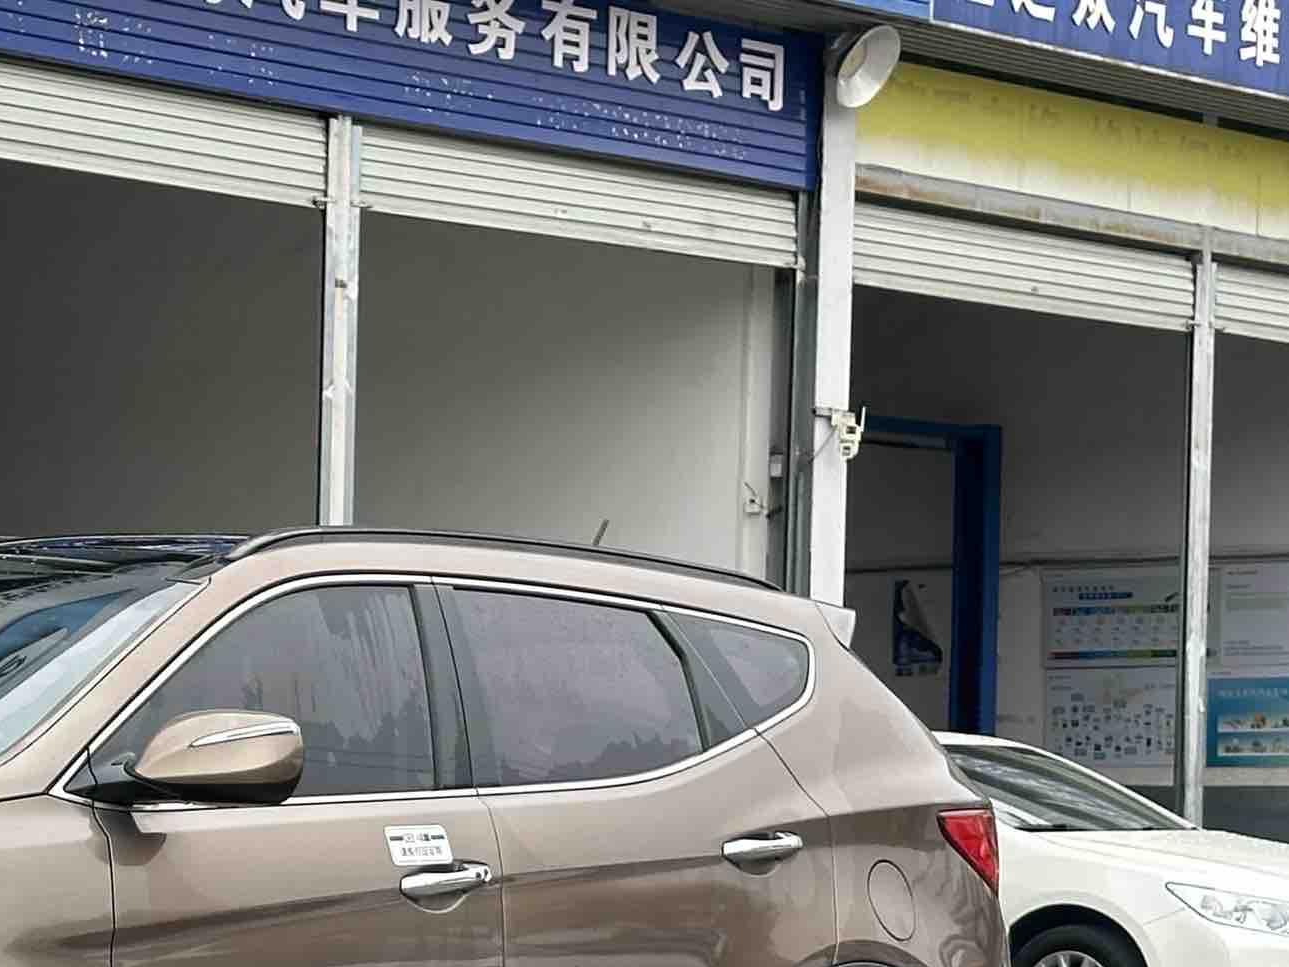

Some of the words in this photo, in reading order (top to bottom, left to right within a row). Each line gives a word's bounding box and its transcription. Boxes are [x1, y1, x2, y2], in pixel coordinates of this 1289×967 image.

[203, 0, 785, 112] 服务有限公司
